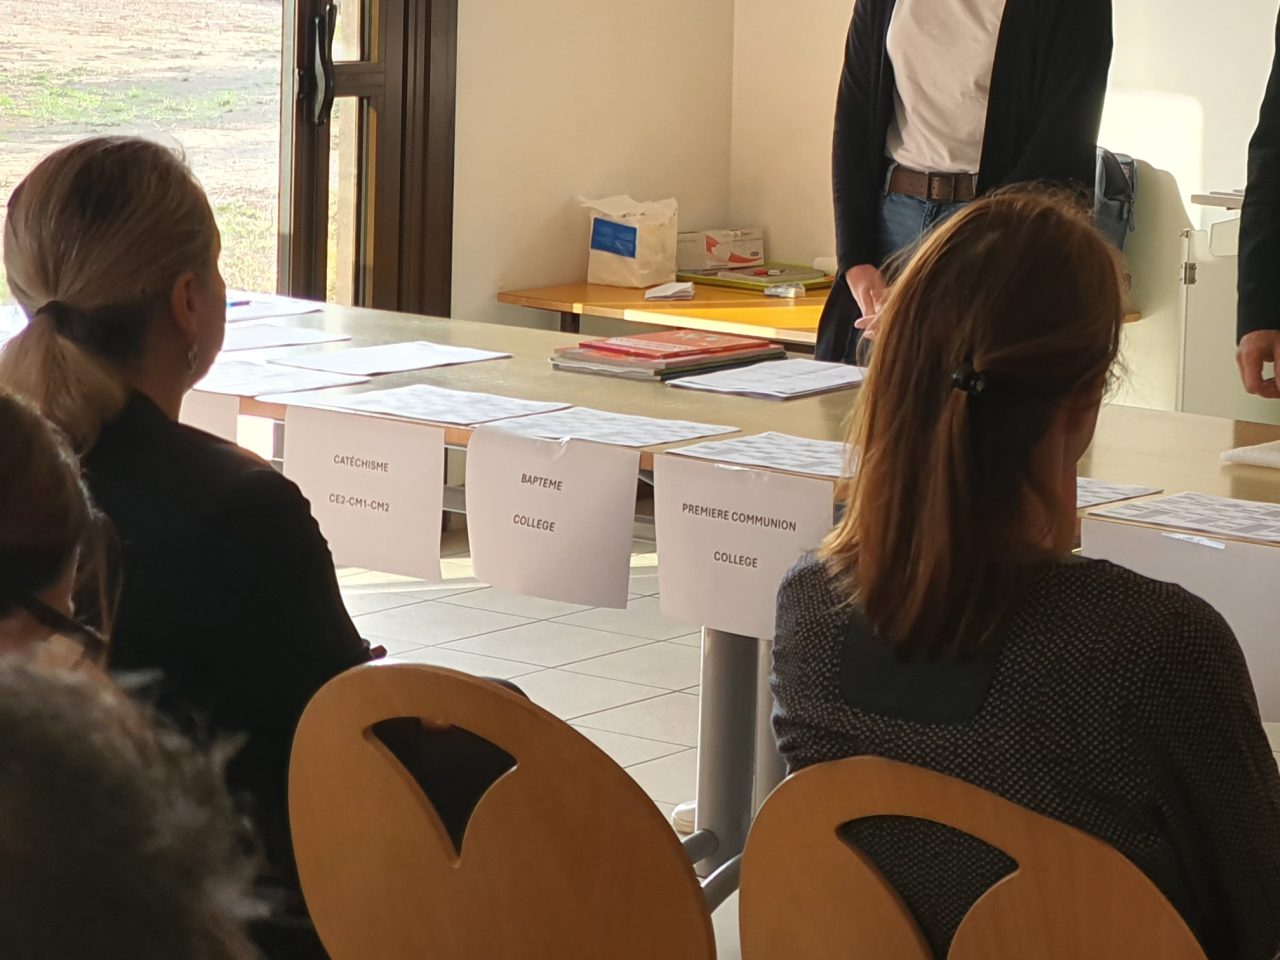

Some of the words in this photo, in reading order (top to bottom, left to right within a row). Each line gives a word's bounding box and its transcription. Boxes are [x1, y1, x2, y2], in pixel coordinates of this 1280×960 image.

[333, 454, 389, 473] CATÉCHISME
[520, 473, 563, 492] BAPTEME
[328, 493, 390, 513] CE2-CM1-CM2
[513, 514, 556, 533] COLLEGE
[682, 503, 730, 521] PREMIERE
[731, 511, 797, 532] COMMUNION
[713, 550, 759, 569] COLLEGE
